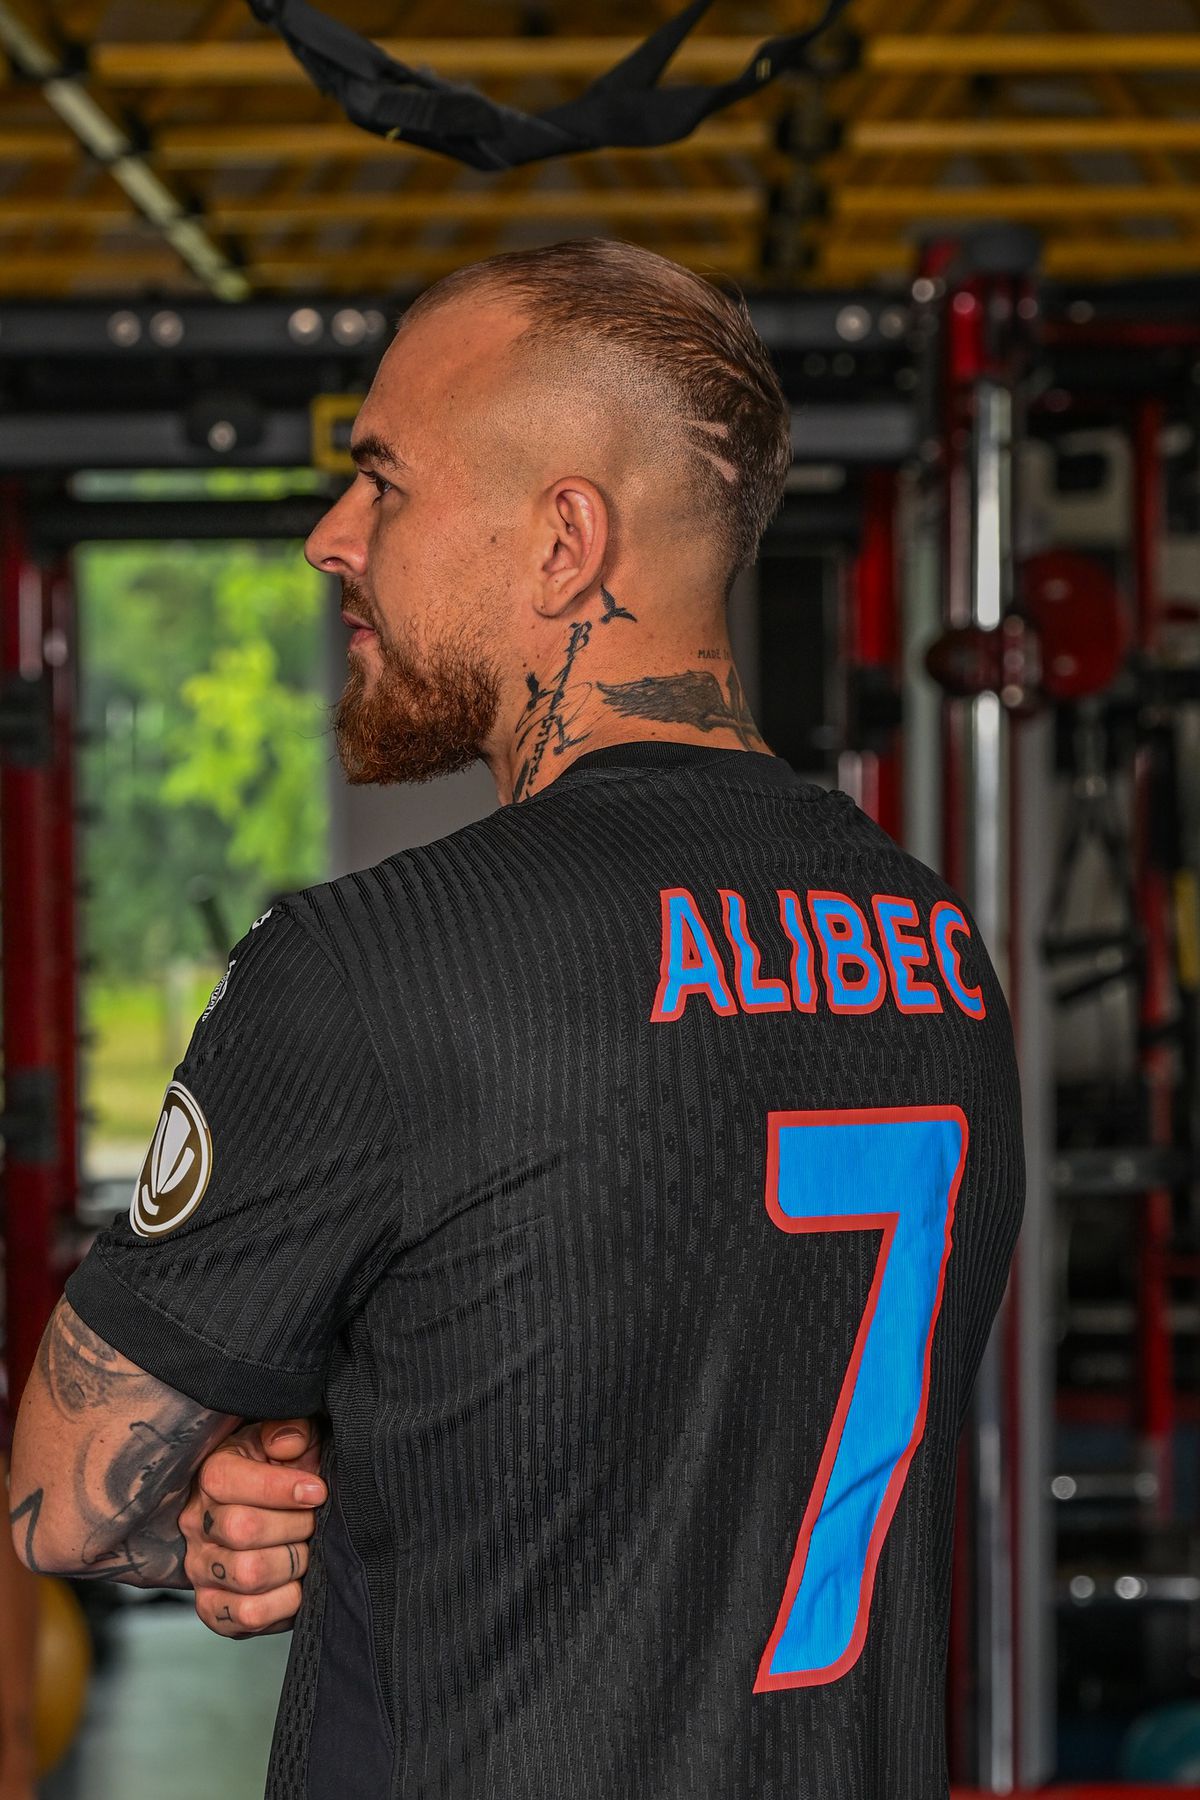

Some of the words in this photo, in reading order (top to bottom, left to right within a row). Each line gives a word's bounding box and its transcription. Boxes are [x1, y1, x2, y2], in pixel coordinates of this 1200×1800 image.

[697, 648, 721, 660] MADE
[650, 888, 986, 1022] ALIBEC
[753, 1105, 969, 1694] 7
